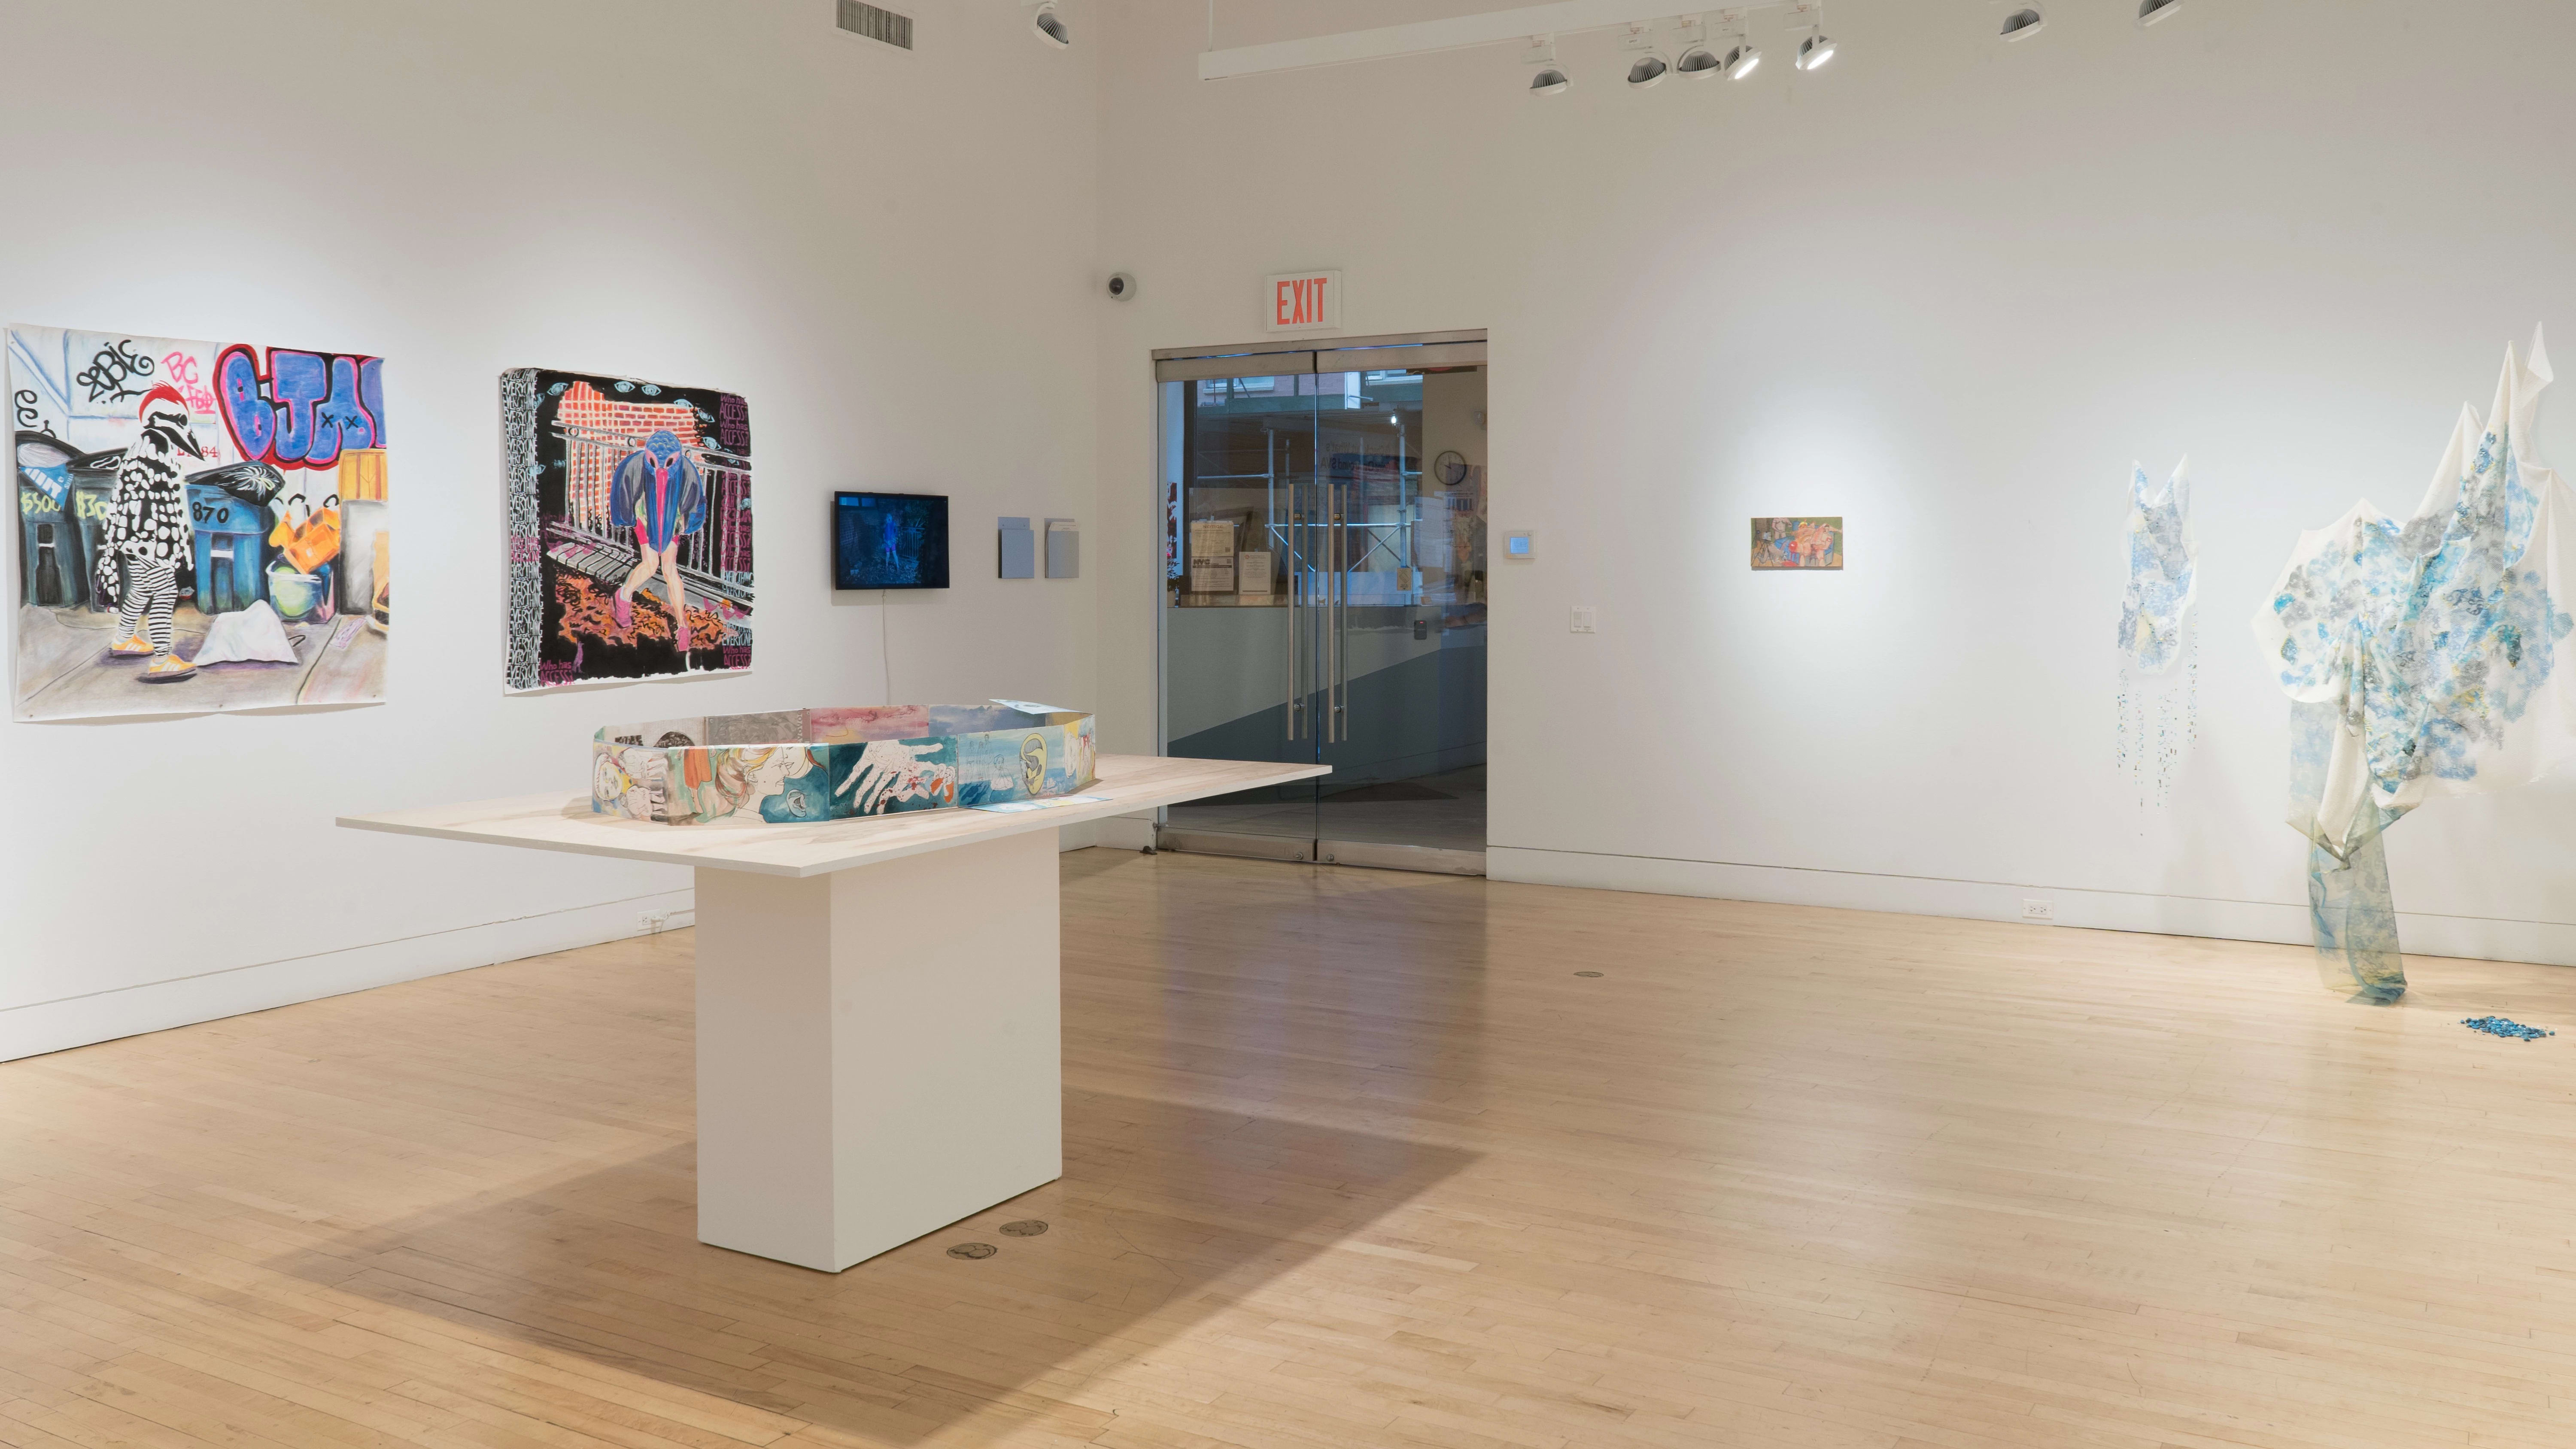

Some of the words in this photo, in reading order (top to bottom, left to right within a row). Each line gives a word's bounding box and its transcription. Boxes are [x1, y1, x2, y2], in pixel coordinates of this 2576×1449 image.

[1277, 278, 1327, 325] EXIT
[501, 379, 537, 396] EVERYONE
[720, 393, 735, 403] Who
[504, 409, 537, 424] EVERYONE
[720, 402, 748, 421] ACCESS?
[506, 421, 537, 439] EVERYTHING
[720, 419, 735, 429] Who
[736, 420, 748, 430] has
[507, 437, 537, 453] EVERYONE
[720, 428, 749, 446] ACCESS?
[510, 494, 540, 509] EVERYONE
[192, 501, 229, 524] 870
[511, 523, 540, 538] EVERYONE
[739, 523, 751, 532] has
[739, 548, 750, 557] has
[510, 578, 543, 594] EVERYONE
[510, 592, 544, 608] EVERYTHING
[510, 607, 544, 623] EVERYONE
[509, 635, 543, 651] EVERYONE
[722, 633, 752, 646] EVERYONE
[723, 646, 738, 654] Who
[540, 660, 557, 670] Who
[559, 660, 572, 669] has
[724, 654, 751, 667] ACCESS?
[506, 663, 541, 679] EVERYONE
